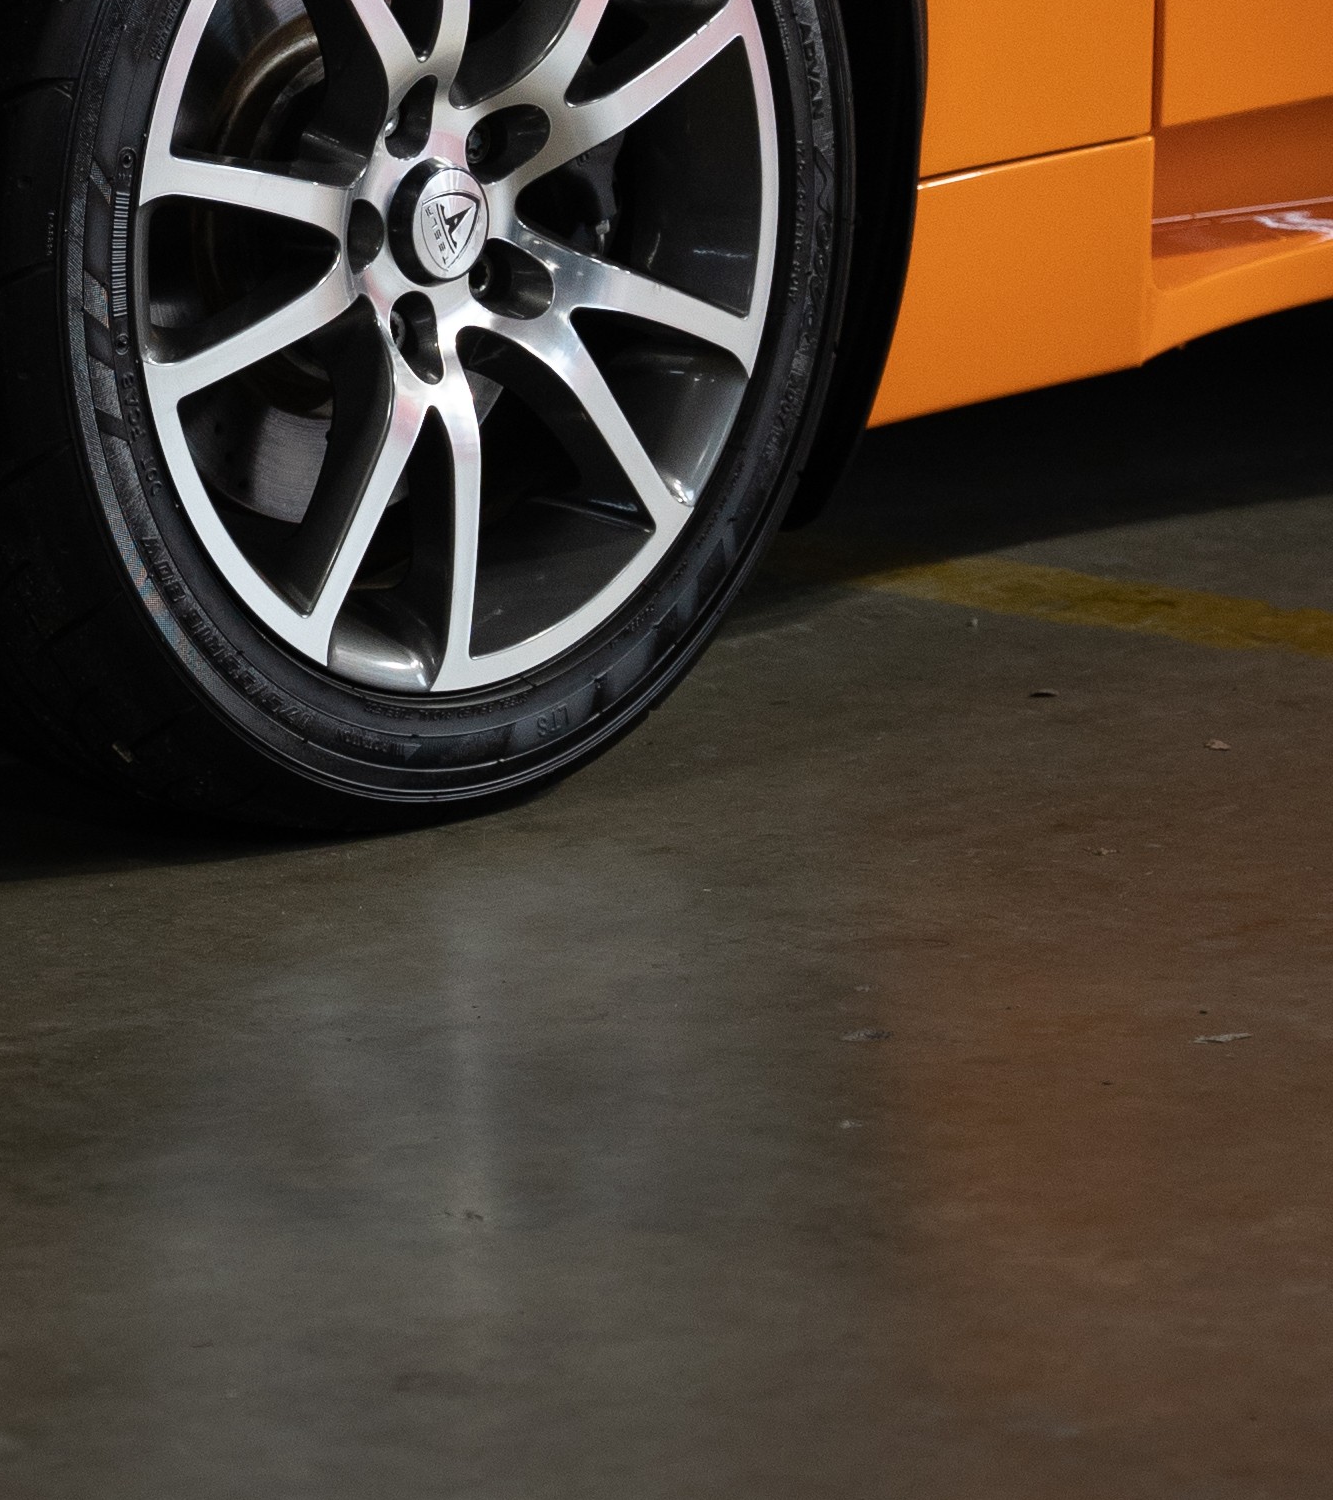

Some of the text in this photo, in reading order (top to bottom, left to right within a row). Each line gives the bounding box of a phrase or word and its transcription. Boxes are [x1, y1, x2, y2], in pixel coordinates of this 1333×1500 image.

[798, 17, 824, 120] ADVAN
[424, 205, 449, 265] TESLA
[139, 530, 186, 610] 80W
[534, 703, 571, 740] LTS
